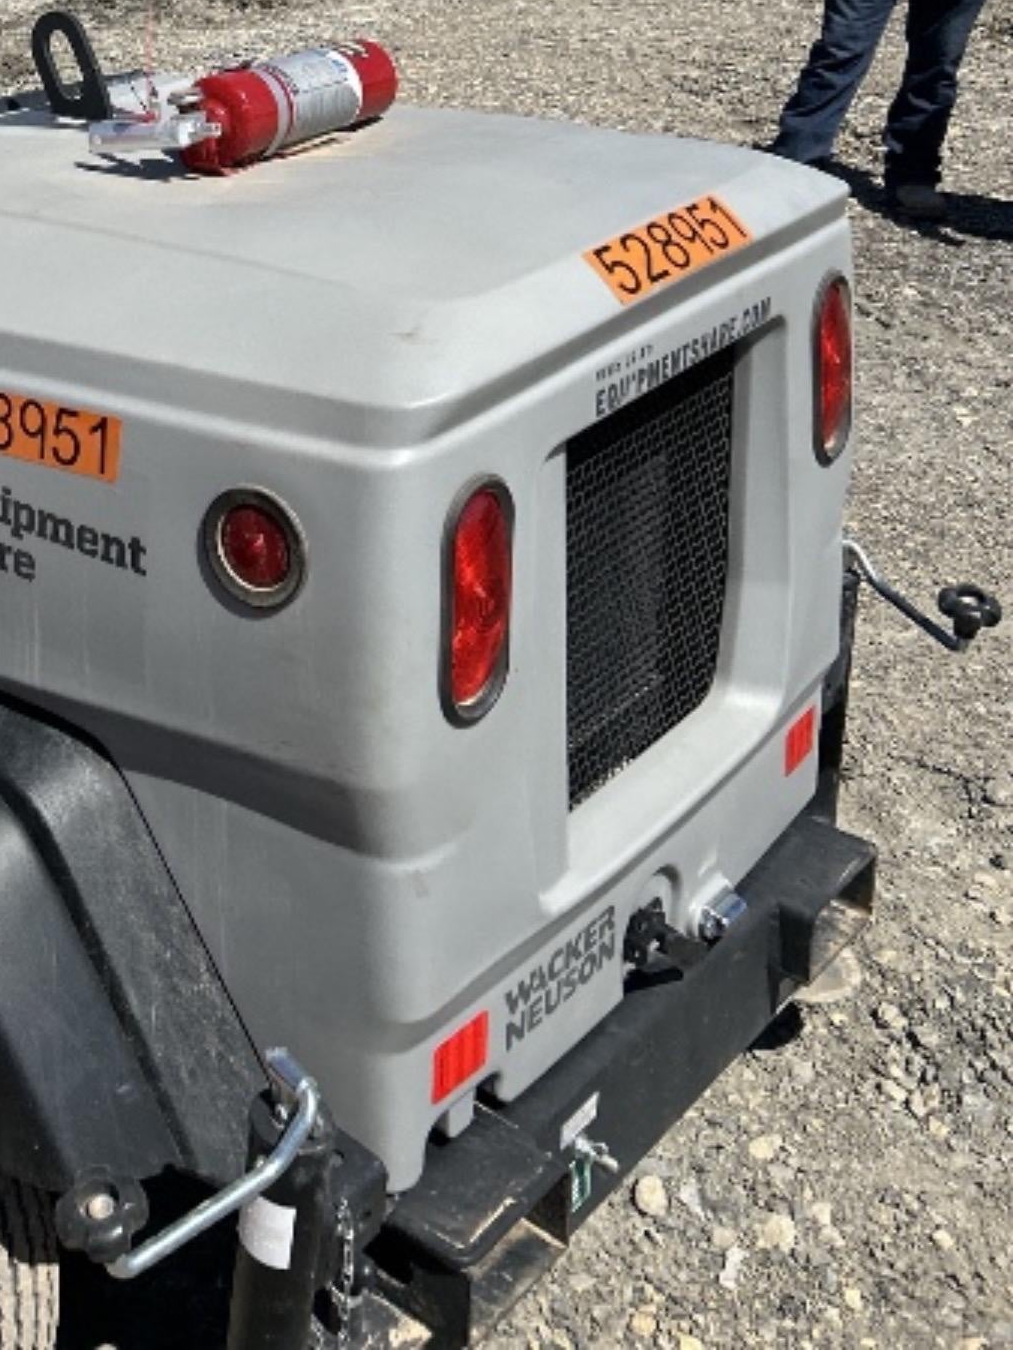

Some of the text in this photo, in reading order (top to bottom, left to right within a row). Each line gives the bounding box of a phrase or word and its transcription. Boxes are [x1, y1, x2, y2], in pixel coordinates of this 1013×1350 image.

[592, 196, 748, 296] 528951
[505, 905, 615, 1016] WACKER
[505, 932, 615, 1053] NEUSON
